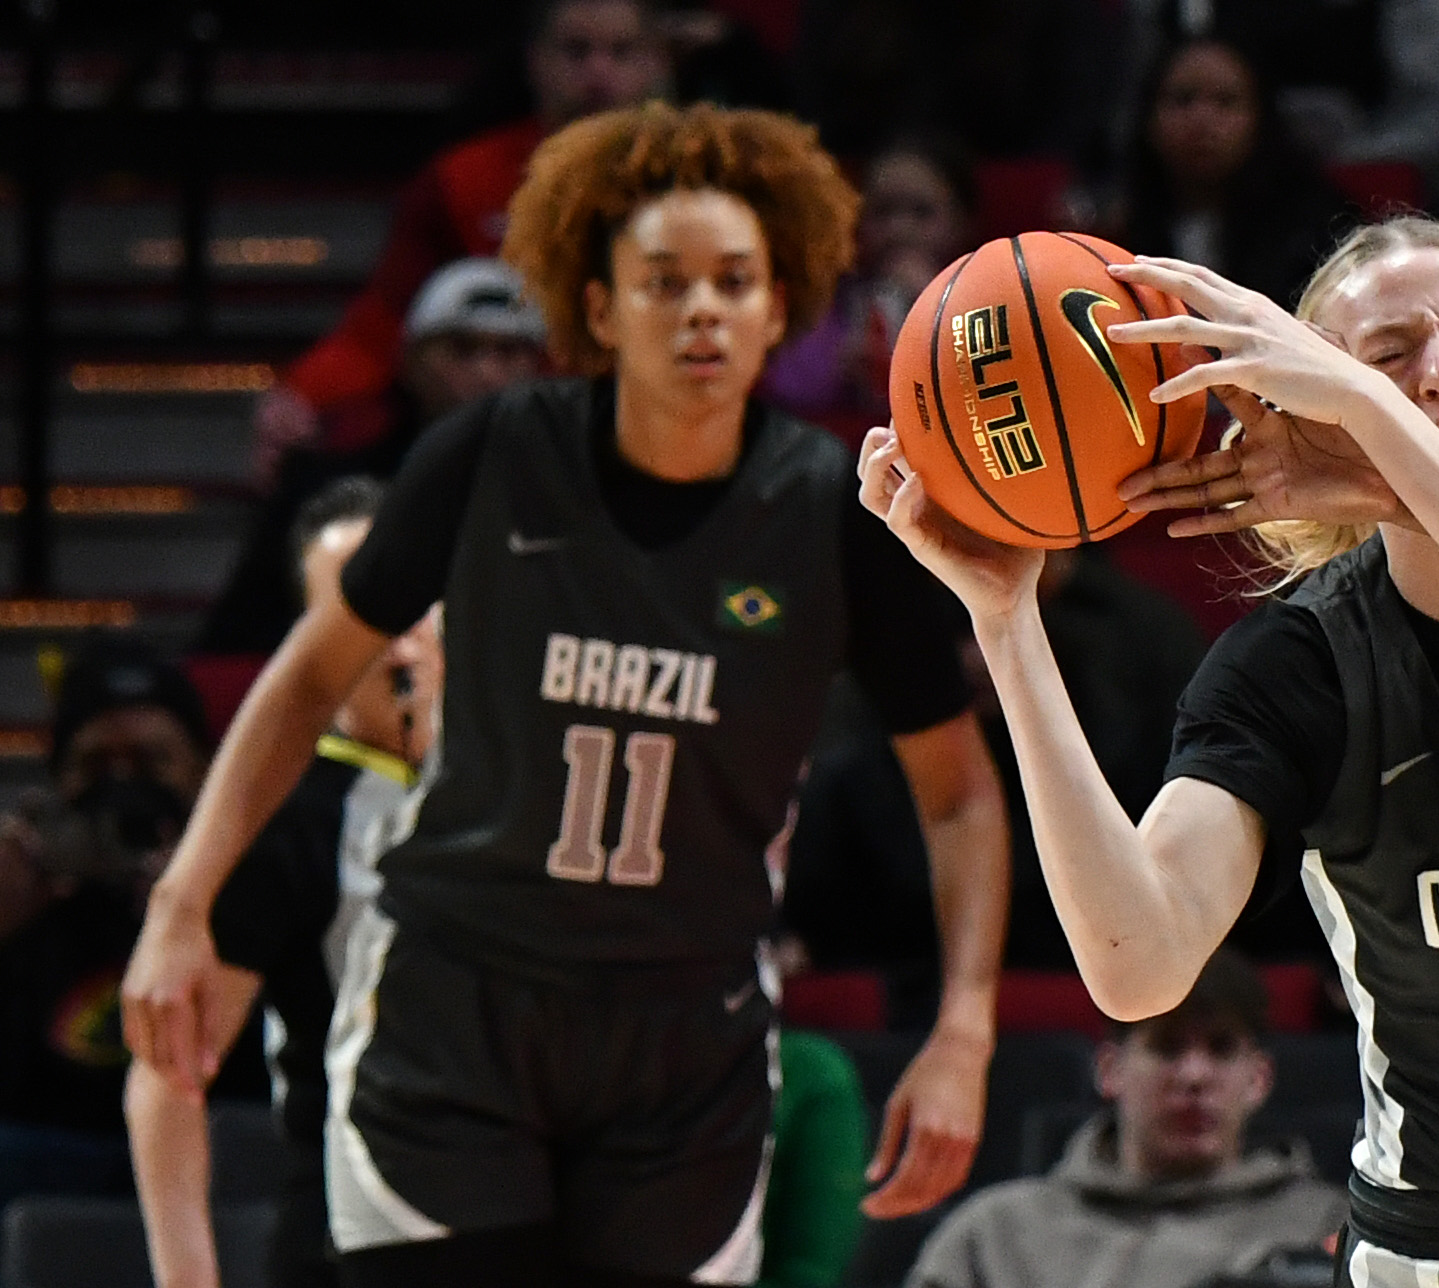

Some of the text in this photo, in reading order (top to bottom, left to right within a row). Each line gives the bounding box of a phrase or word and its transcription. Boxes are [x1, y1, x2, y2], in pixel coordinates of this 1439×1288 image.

[965, 304, 1047, 479] ELITE
[543, 633, 720, 724] BRAZIL
[547, 725, 676, 886] 11
